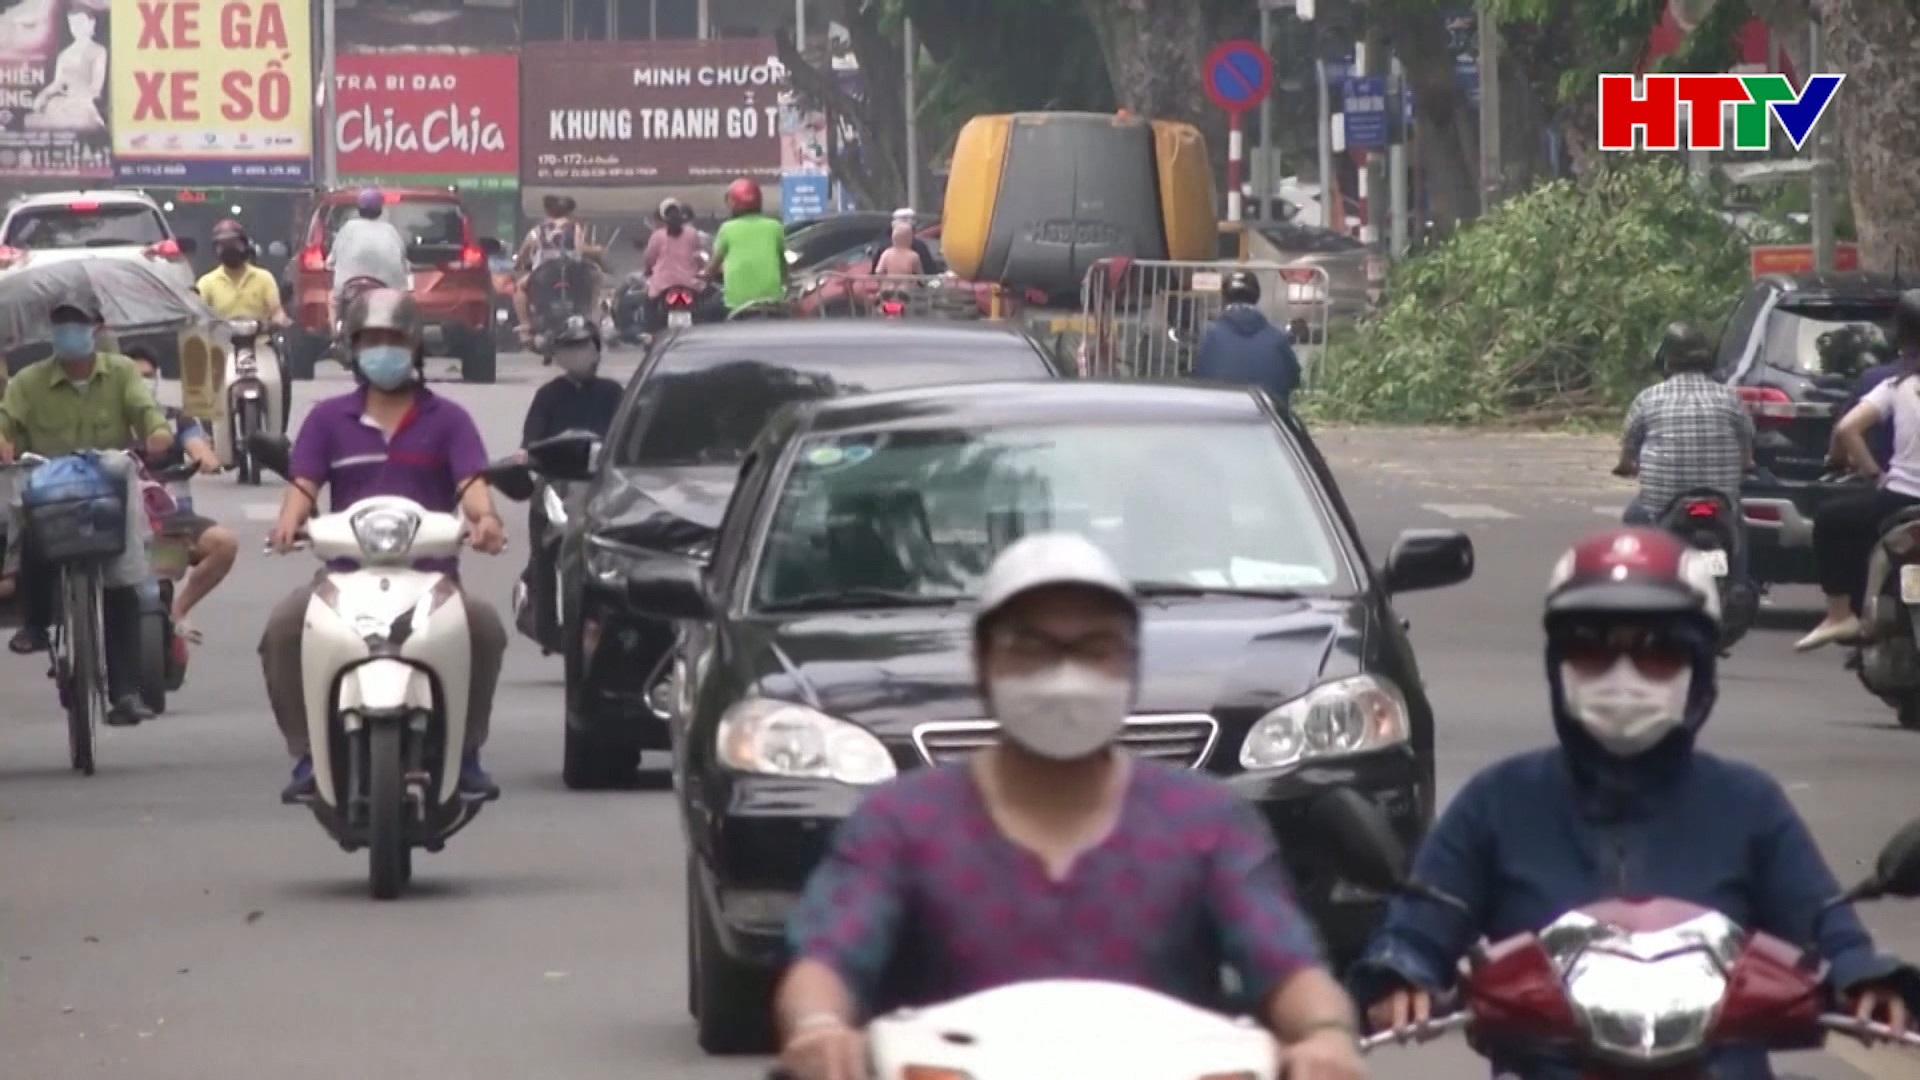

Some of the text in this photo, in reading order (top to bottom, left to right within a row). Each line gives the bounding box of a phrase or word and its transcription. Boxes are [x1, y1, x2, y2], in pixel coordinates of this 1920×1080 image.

[137, 2, 288, 49] XE GA
[133, 52, 291, 121] XE SỐ
[634, 67, 691, 86] MINH
[550, 108, 632, 140] KHUNG
[641, 106, 719, 139] TRANH
